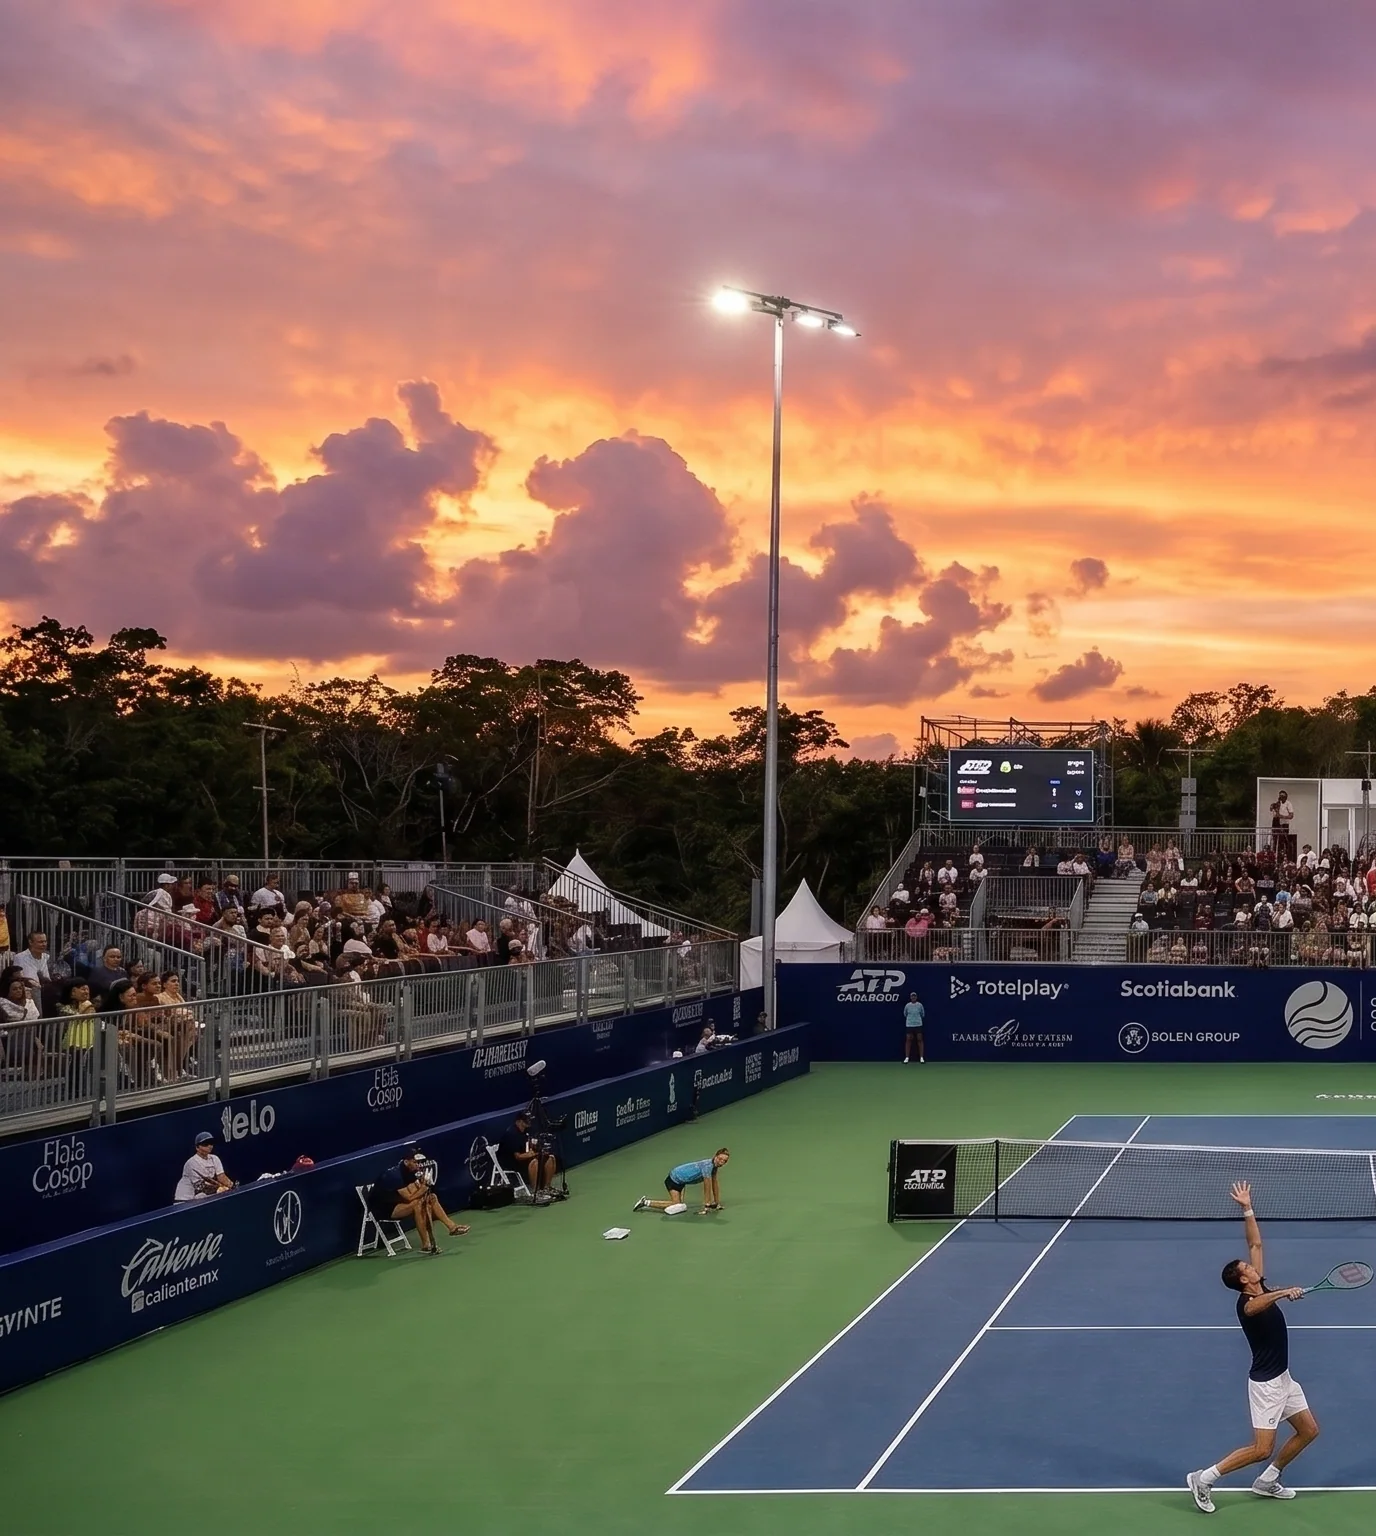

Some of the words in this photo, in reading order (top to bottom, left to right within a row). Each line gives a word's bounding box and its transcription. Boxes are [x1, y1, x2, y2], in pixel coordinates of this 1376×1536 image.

[836, 969, 905, 992] ATP
[1120, 980, 1236, 998] Scotiabank
[1151, 1032, 1194, 1042] SOLEN
[1196, 1032, 1240, 1042] GROUP
[145, 1269, 220, 1306] caliente.mx
